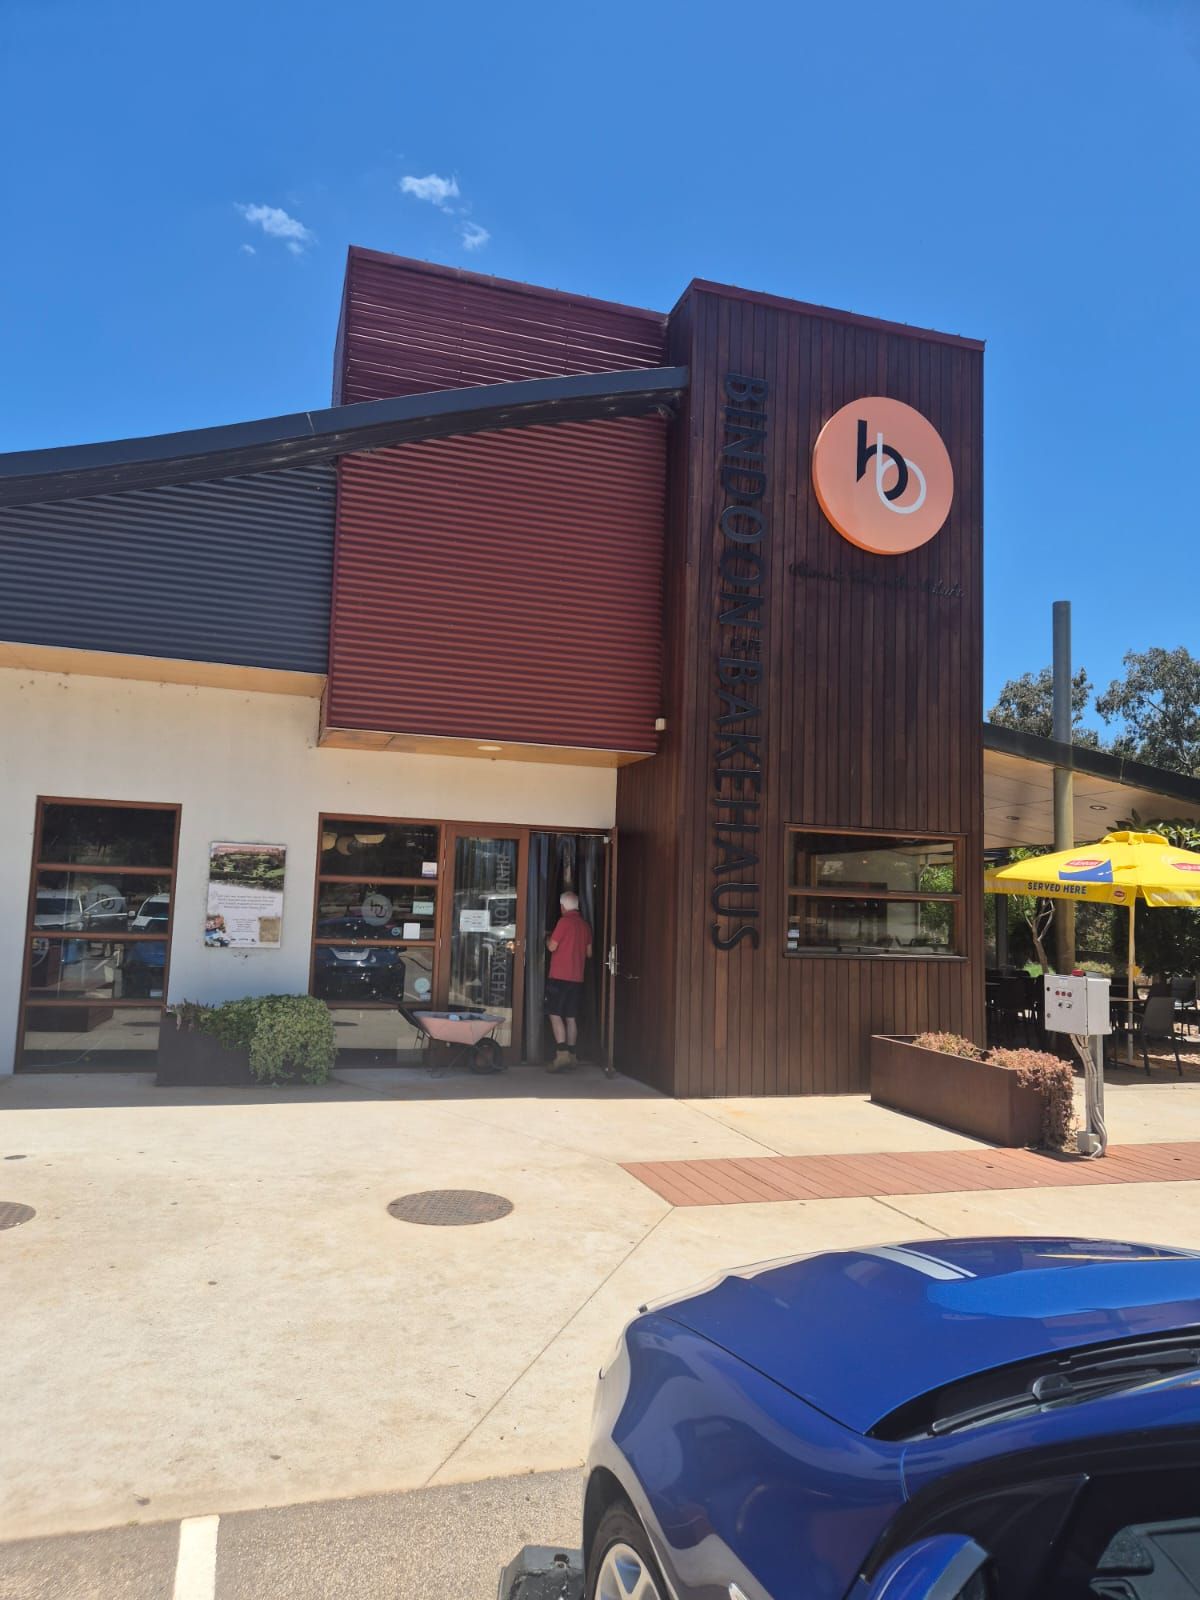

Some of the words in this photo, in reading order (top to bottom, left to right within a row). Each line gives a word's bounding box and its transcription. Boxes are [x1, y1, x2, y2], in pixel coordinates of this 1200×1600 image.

[719, 372, 768, 629] BINDOON
[711, 657, 763, 951] BAKEHAUS
[1027, 882, 1060, 893] SERVED
[1063, 884, 1087, 895] HERE
